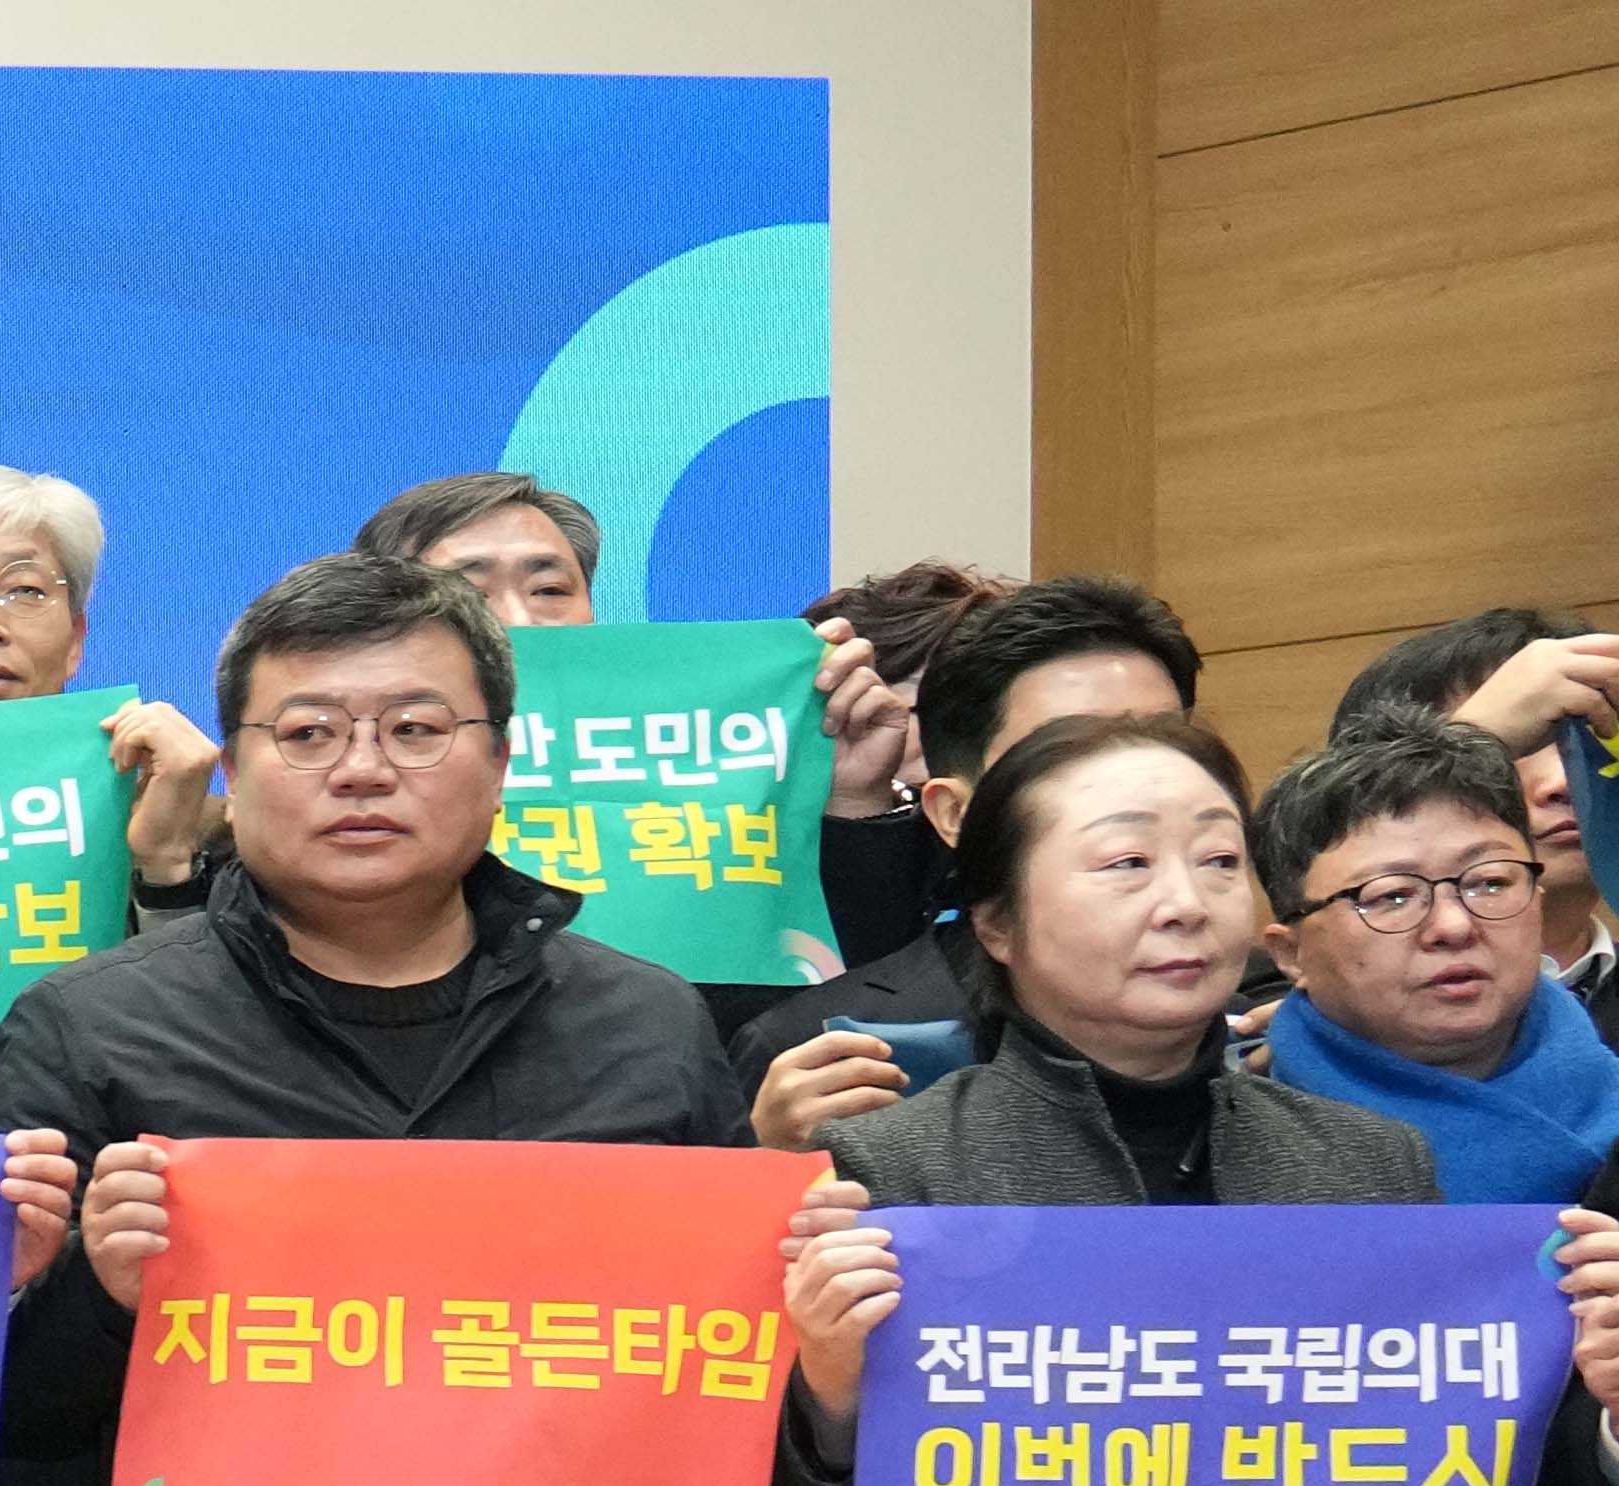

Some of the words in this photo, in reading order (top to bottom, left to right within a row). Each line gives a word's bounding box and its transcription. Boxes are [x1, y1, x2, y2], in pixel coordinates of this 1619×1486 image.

[569, 706, 790, 787] 도민의
[623, 800, 784, 892] 확보
[153, 1291, 407, 1387] 지금이
[431, 1298, 781, 1402] 골든타임
[915, 1323, 1204, 1406] 전라남도
[1216, 1320, 1520, 1406] 국립의대
